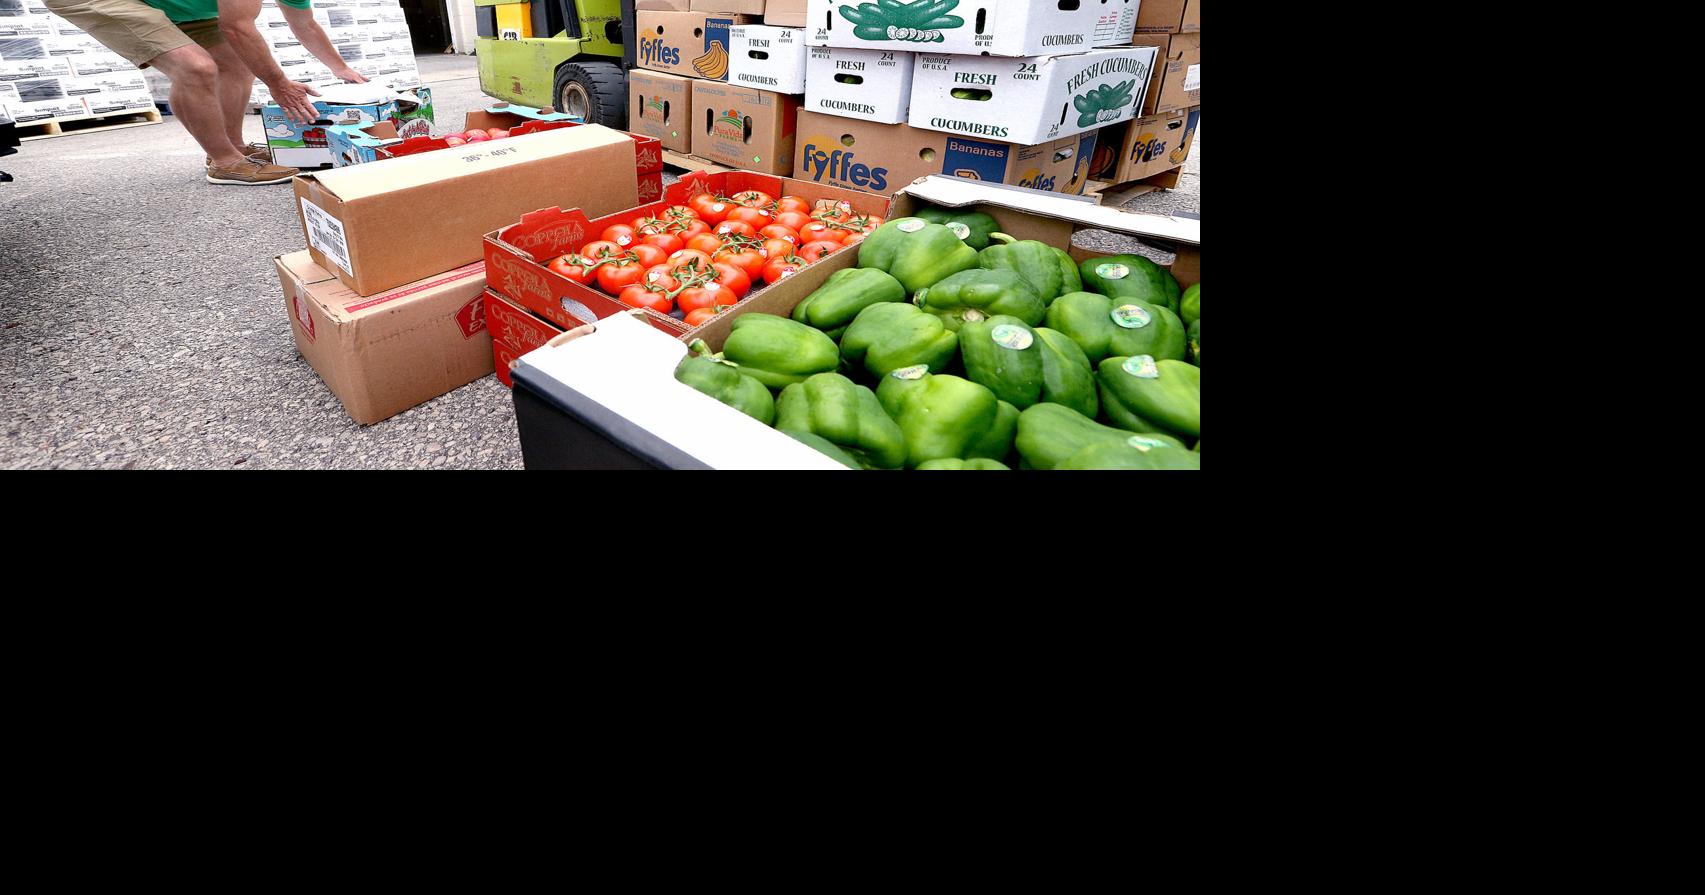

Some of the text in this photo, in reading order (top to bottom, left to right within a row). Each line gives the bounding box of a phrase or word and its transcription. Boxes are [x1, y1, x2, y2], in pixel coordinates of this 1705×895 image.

[780, 30, 791, 38] 24
[817, 27, 827, 35] 24
[748, 38, 770, 48] FRESH
[1041, 33, 1084, 47] CUCUMBERS
[880, 52, 895, 62] 24
[921, 56, 952, 66] PRODUCE
[836, 60, 866, 72] FRESH
[1017, 62, 1038, 74] 24
[737, 73, 778, 86] CUCUMBERS
[954, 71, 998, 87] FRESH
[1012, 72, 1042, 82] COUNT
[1067, 62, 1100, 96] FRESH
[1100, 56, 1148, 81] CUCUMBERS
[819, 98, 876, 115] CUCUMBERS
[930, 116, 1010, 138] CUCUMBERS
[1050, 122, 1060, 133] 24
[949, 141, 1005, 159] Bananas
